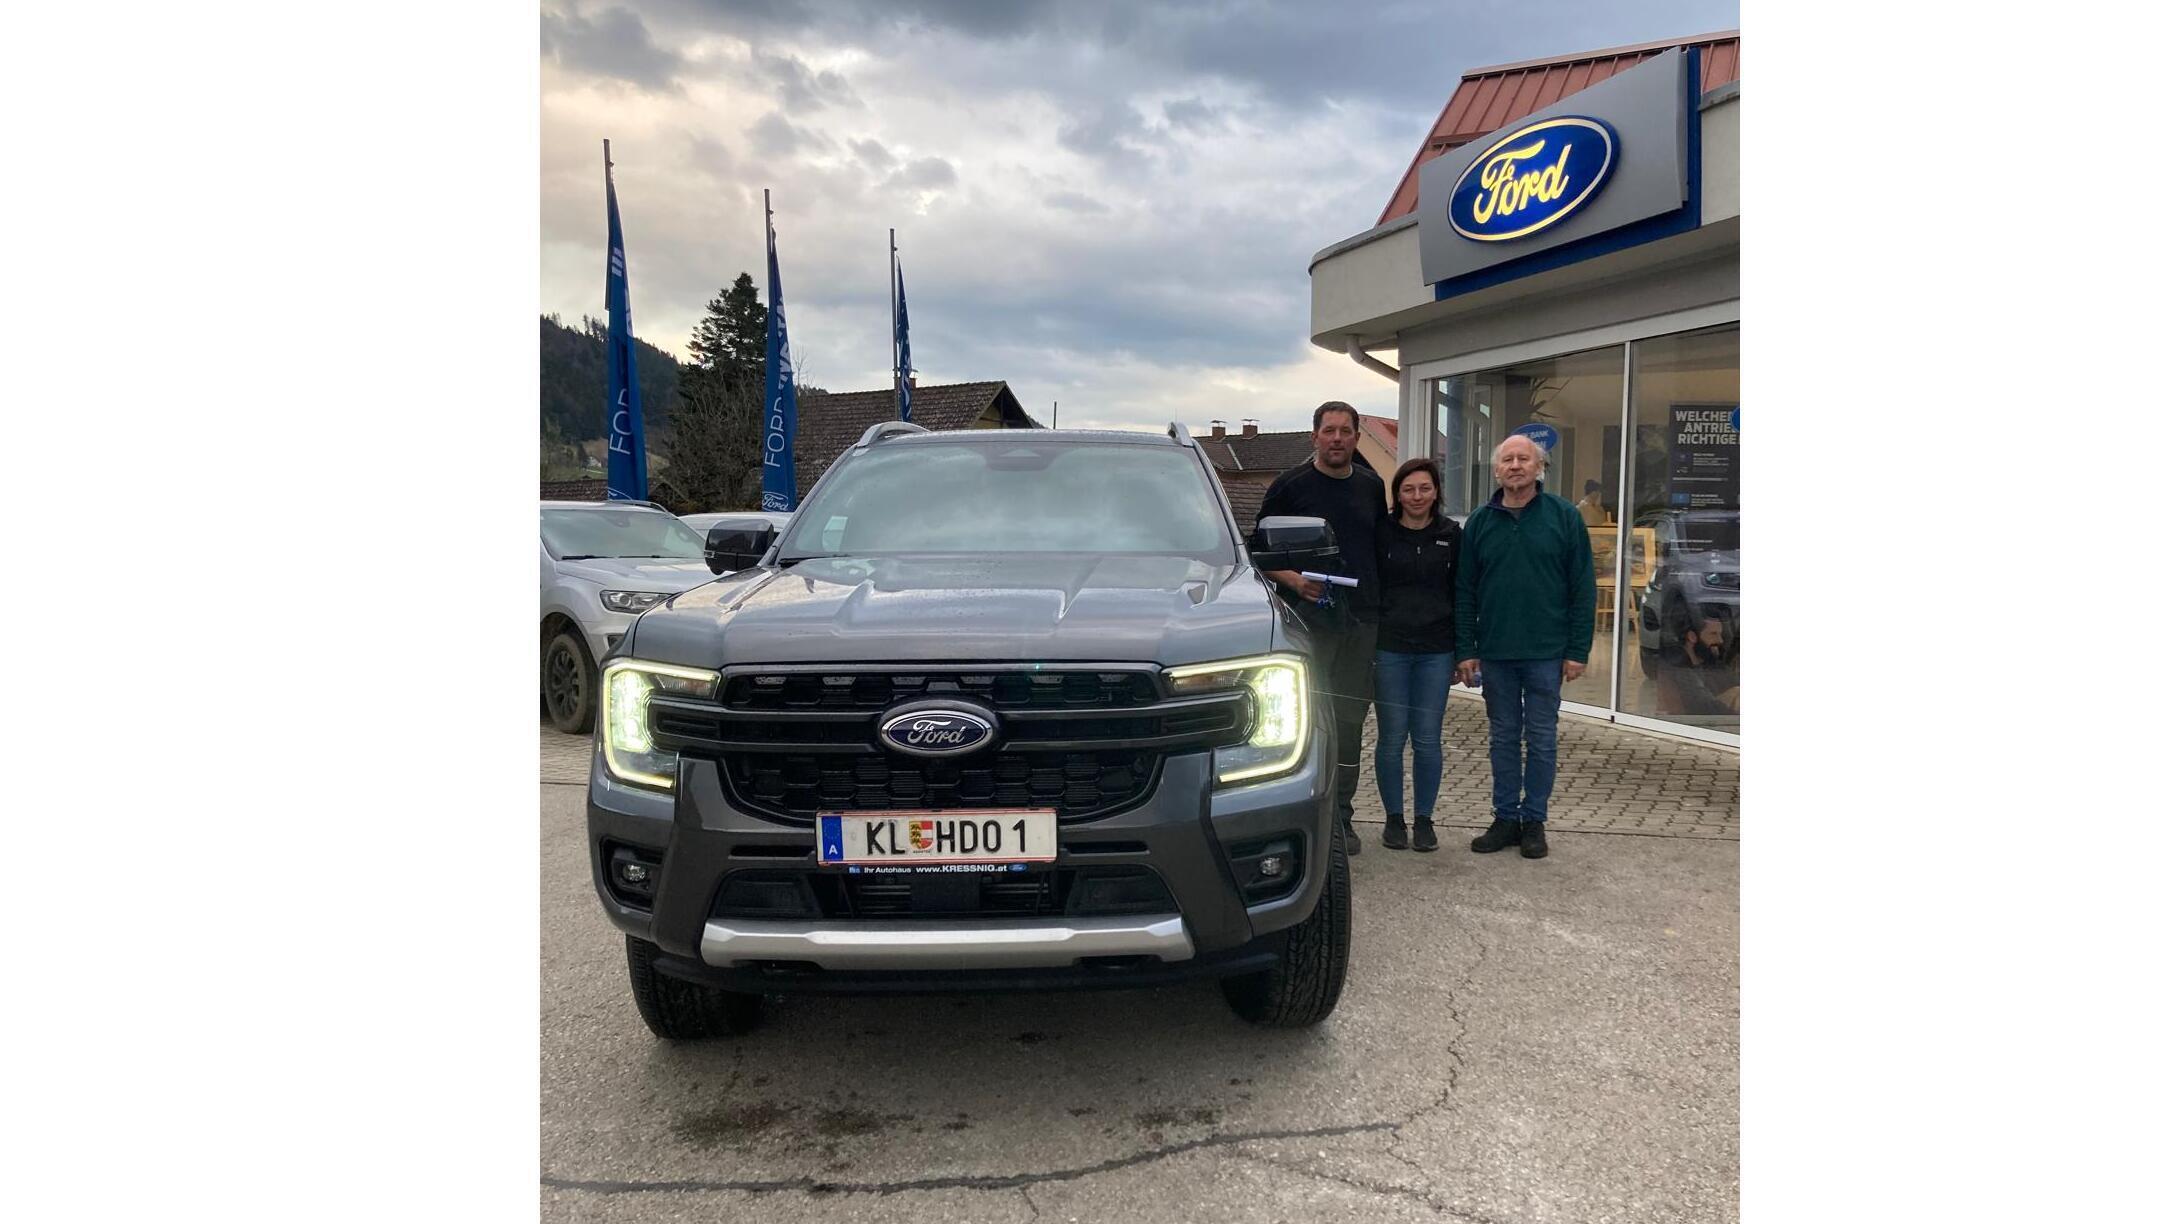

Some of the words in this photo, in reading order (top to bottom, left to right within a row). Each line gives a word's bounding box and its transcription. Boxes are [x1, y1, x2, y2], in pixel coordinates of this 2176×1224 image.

[1473, 139, 1572, 224] Ford
[1683, 422, 1736, 433] ANTRIE
[762, 493, 789, 511] Ford
[907, 719, 968, 744] Ford
[866, 821, 906, 855] KL
[936, 819, 1002, 854] HDO
[1012, 819, 1026, 853] 1
[828, 844, 838, 855] A
[864, 866, 874, 874] Ihr
[875, 866, 912, 874] Autohaus
[916, 864, 1008, 873] www.KRESSNIG.at
